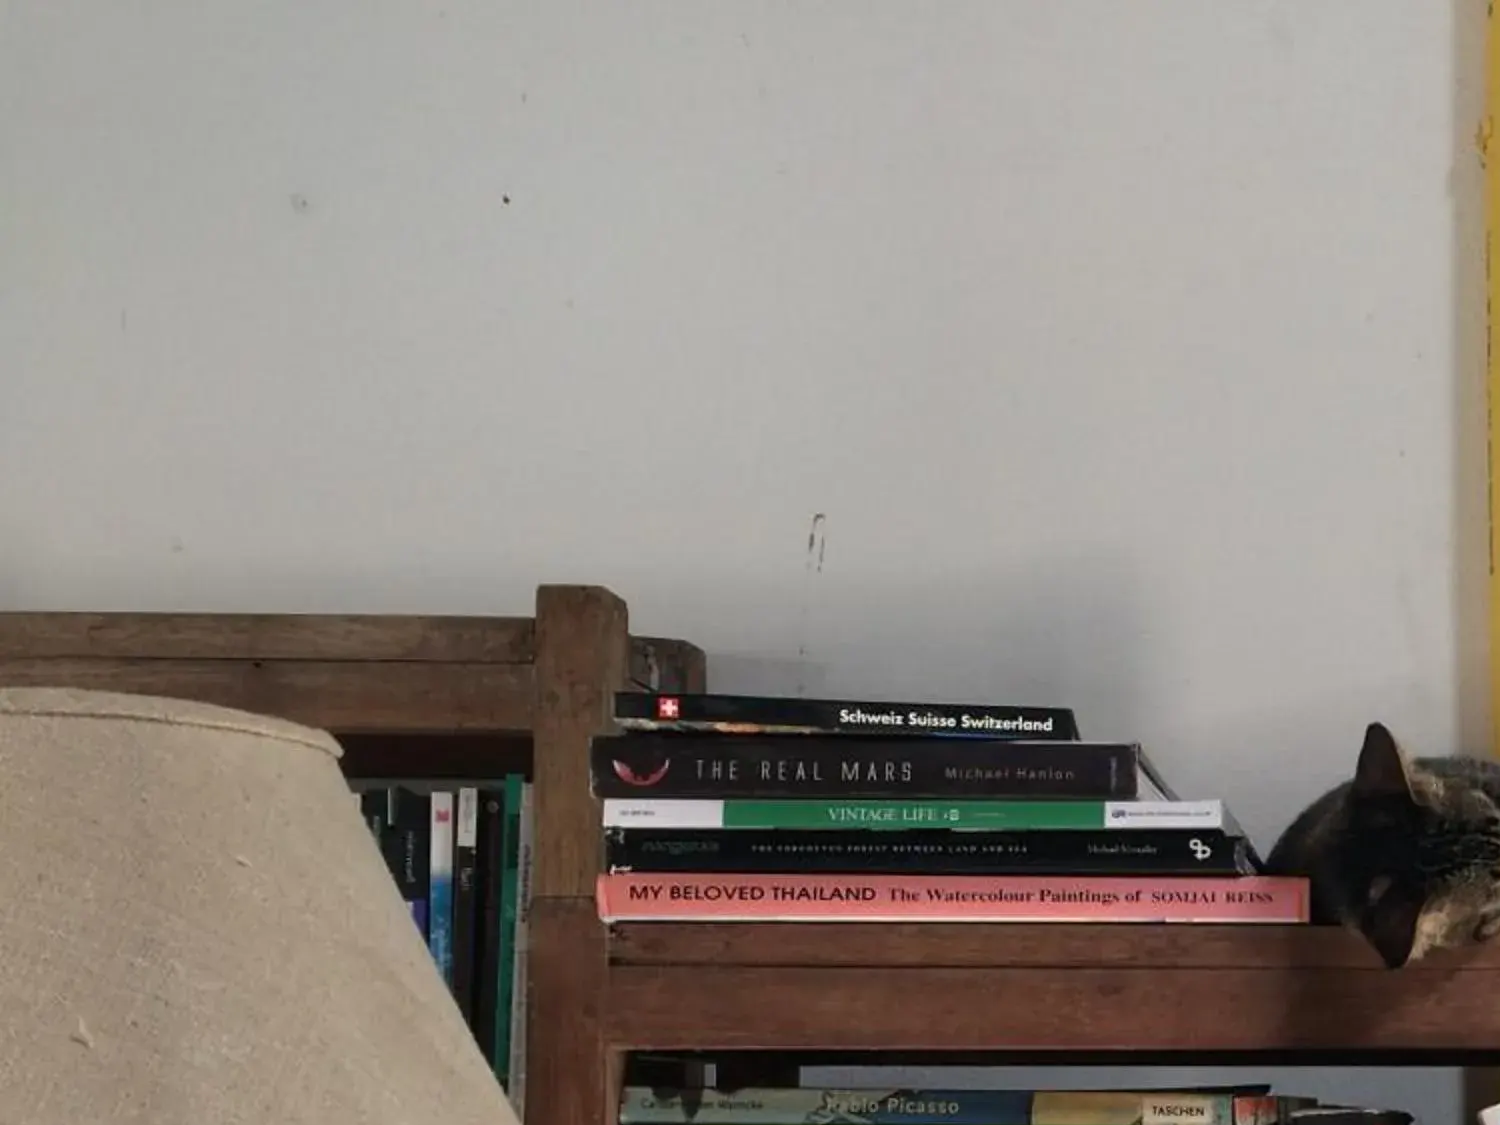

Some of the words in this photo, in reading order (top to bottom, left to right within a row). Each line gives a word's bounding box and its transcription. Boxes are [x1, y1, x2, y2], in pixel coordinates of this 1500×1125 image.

[840, 709, 903, 725] Schweiz
[908, 712, 957, 728] Suisse
[960, 714, 1054, 732] Switzerland
[696, 759, 739, 781] THE
[761, 760, 823, 781] REAL
[840, 760, 913, 782] MARS
[945, 766, 1010, 781] Michael
[1016, 767, 1076, 781] Hanlon
[827, 807, 897, 822] VINTAGE
[902, 807, 938, 822] LIFE
[629, 886, 664, 902] MY
[669, 886, 765, 902] BELOVED
[772, 886, 877, 902] THAILAND
[887, 887, 922, 902] The
[926, 889, 1036, 903] Watercolour
[1039, 888, 1120, 908] Paintings
[1124, 889, 1142, 903] of
[887, 1098, 960, 1114] Picasso
[1152, 1105, 1206, 1117] TASCHEN
